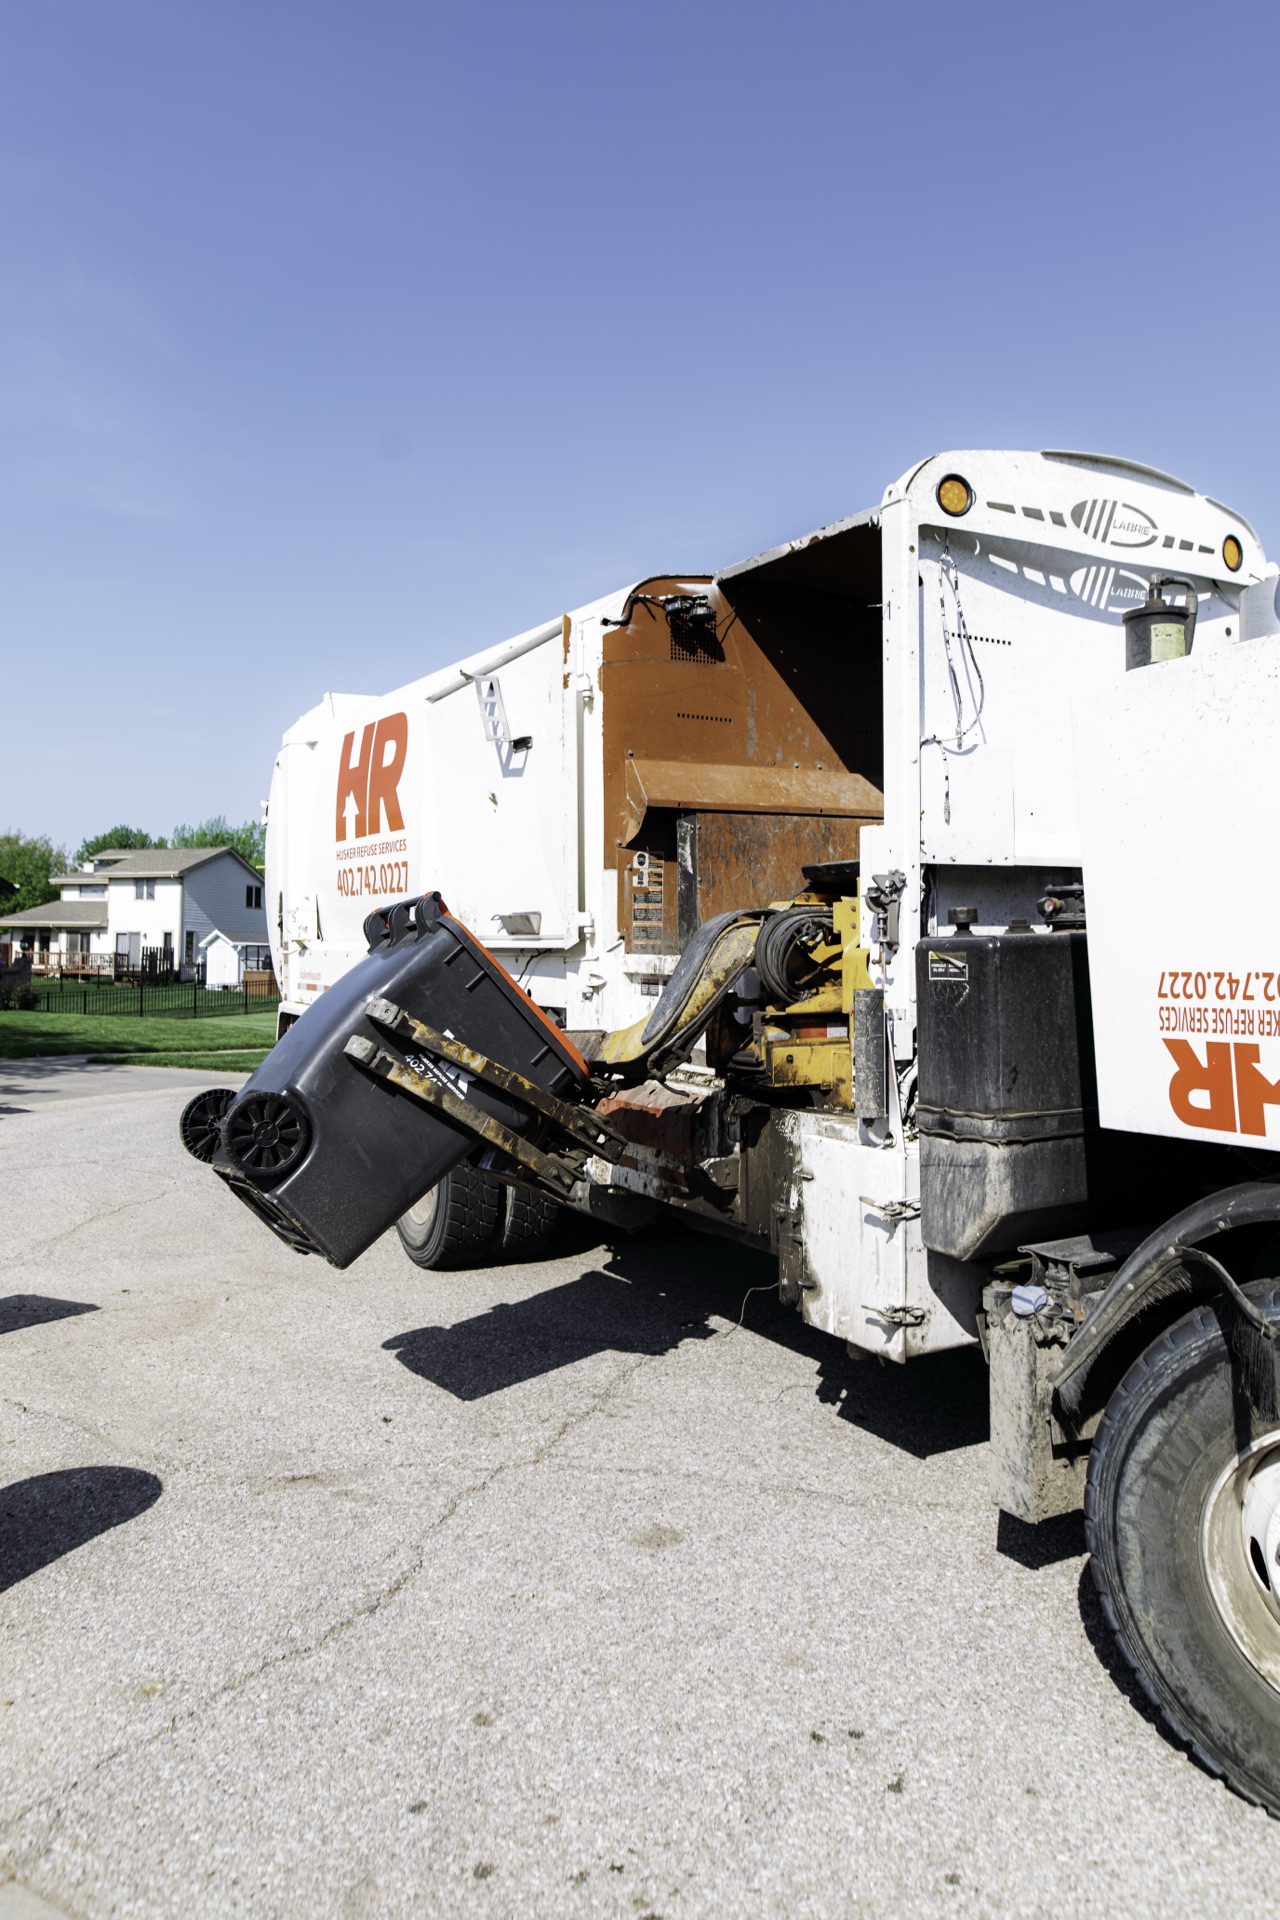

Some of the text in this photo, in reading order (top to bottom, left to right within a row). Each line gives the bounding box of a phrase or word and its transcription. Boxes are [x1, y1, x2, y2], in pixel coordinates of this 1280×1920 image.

[1112, 519, 1151, 535] LABRIE
[335, 711, 408, 842] HR
[336, 838, 407, 861] HUSKER REFUSE SERVICES
[337, 861, 408, 897] 402.742.0227
[1157, 971, 1280, 1002] 2.742.0227
[1158, 1006, 1209, 1033] SERVICES
[1211, 1007, 1255, 1036] REFUSE
